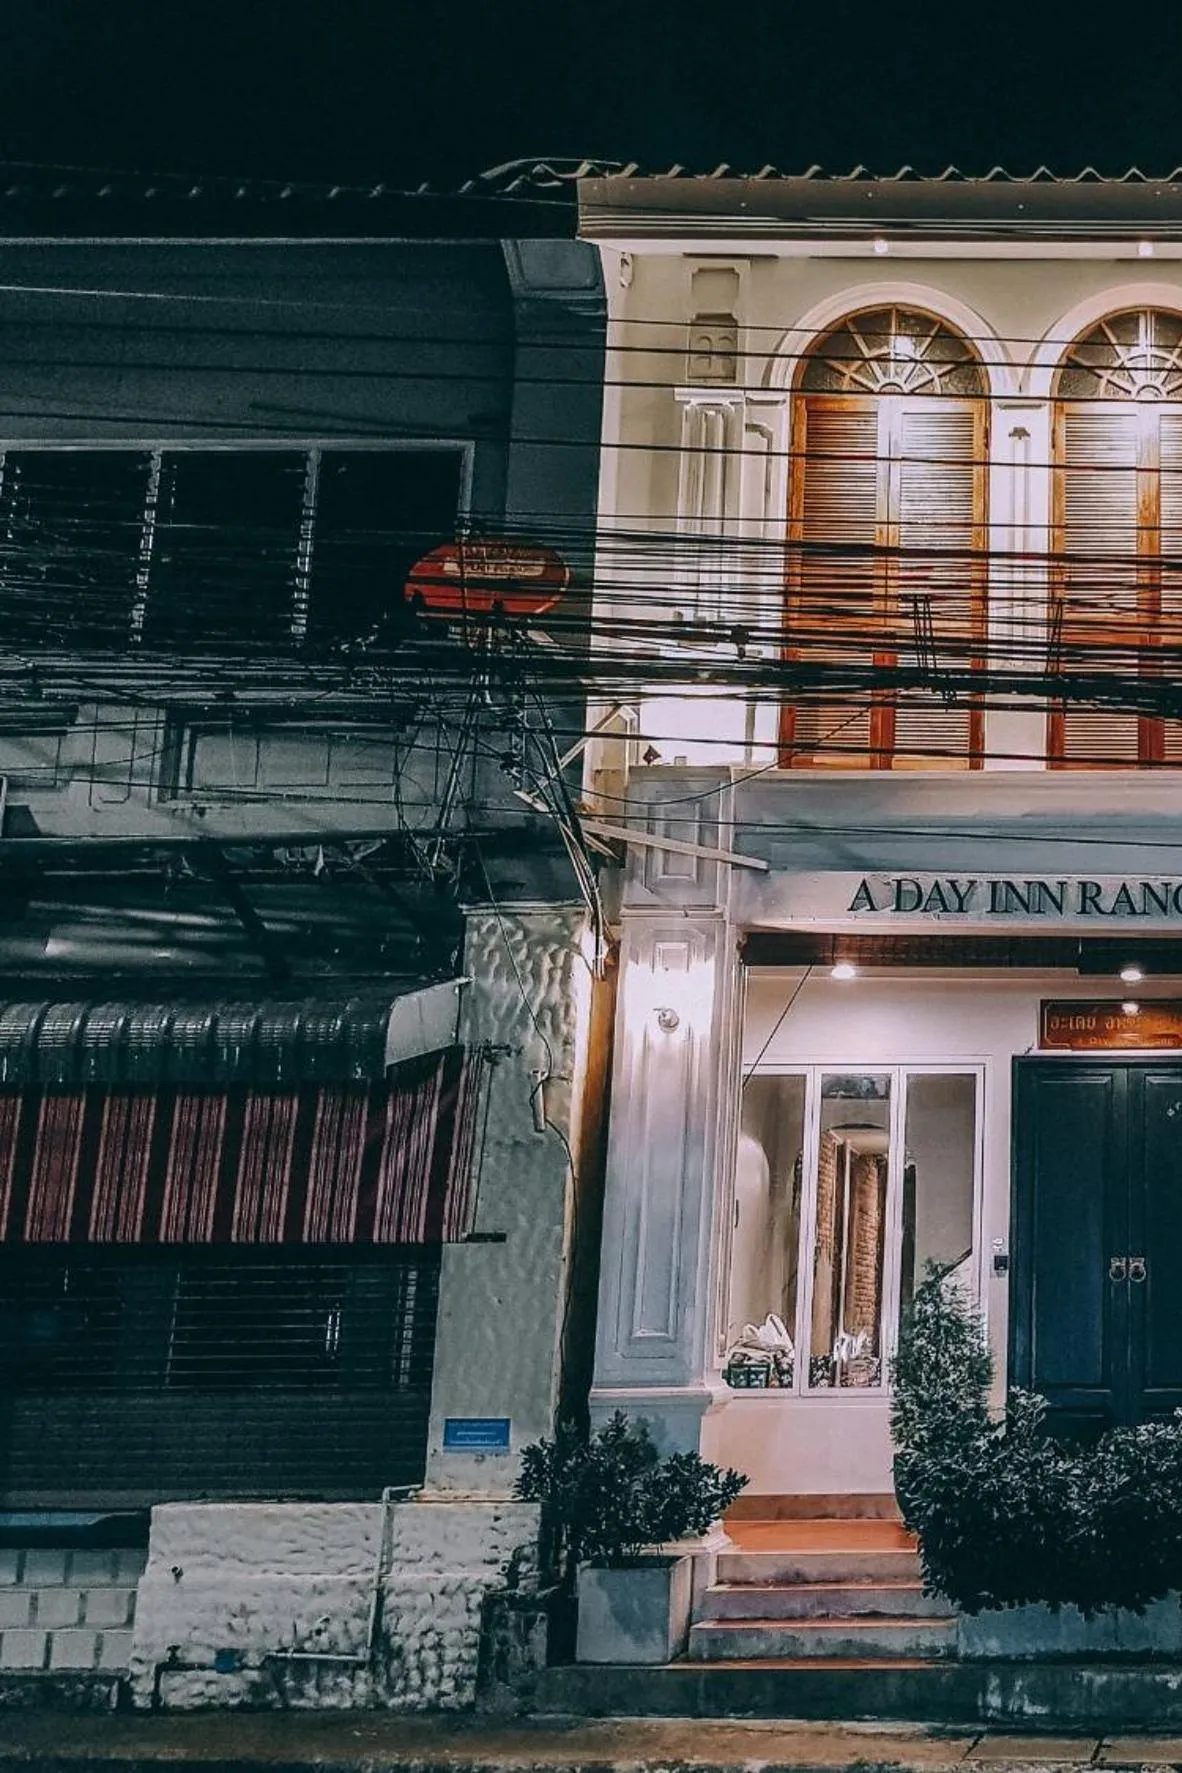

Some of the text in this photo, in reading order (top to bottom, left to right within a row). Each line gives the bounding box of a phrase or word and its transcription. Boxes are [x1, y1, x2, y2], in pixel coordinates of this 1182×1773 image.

[848, 879, 879, 912] A
[890, 878, 977, 913] DAY
[985, 880, 1067, 916] INN
